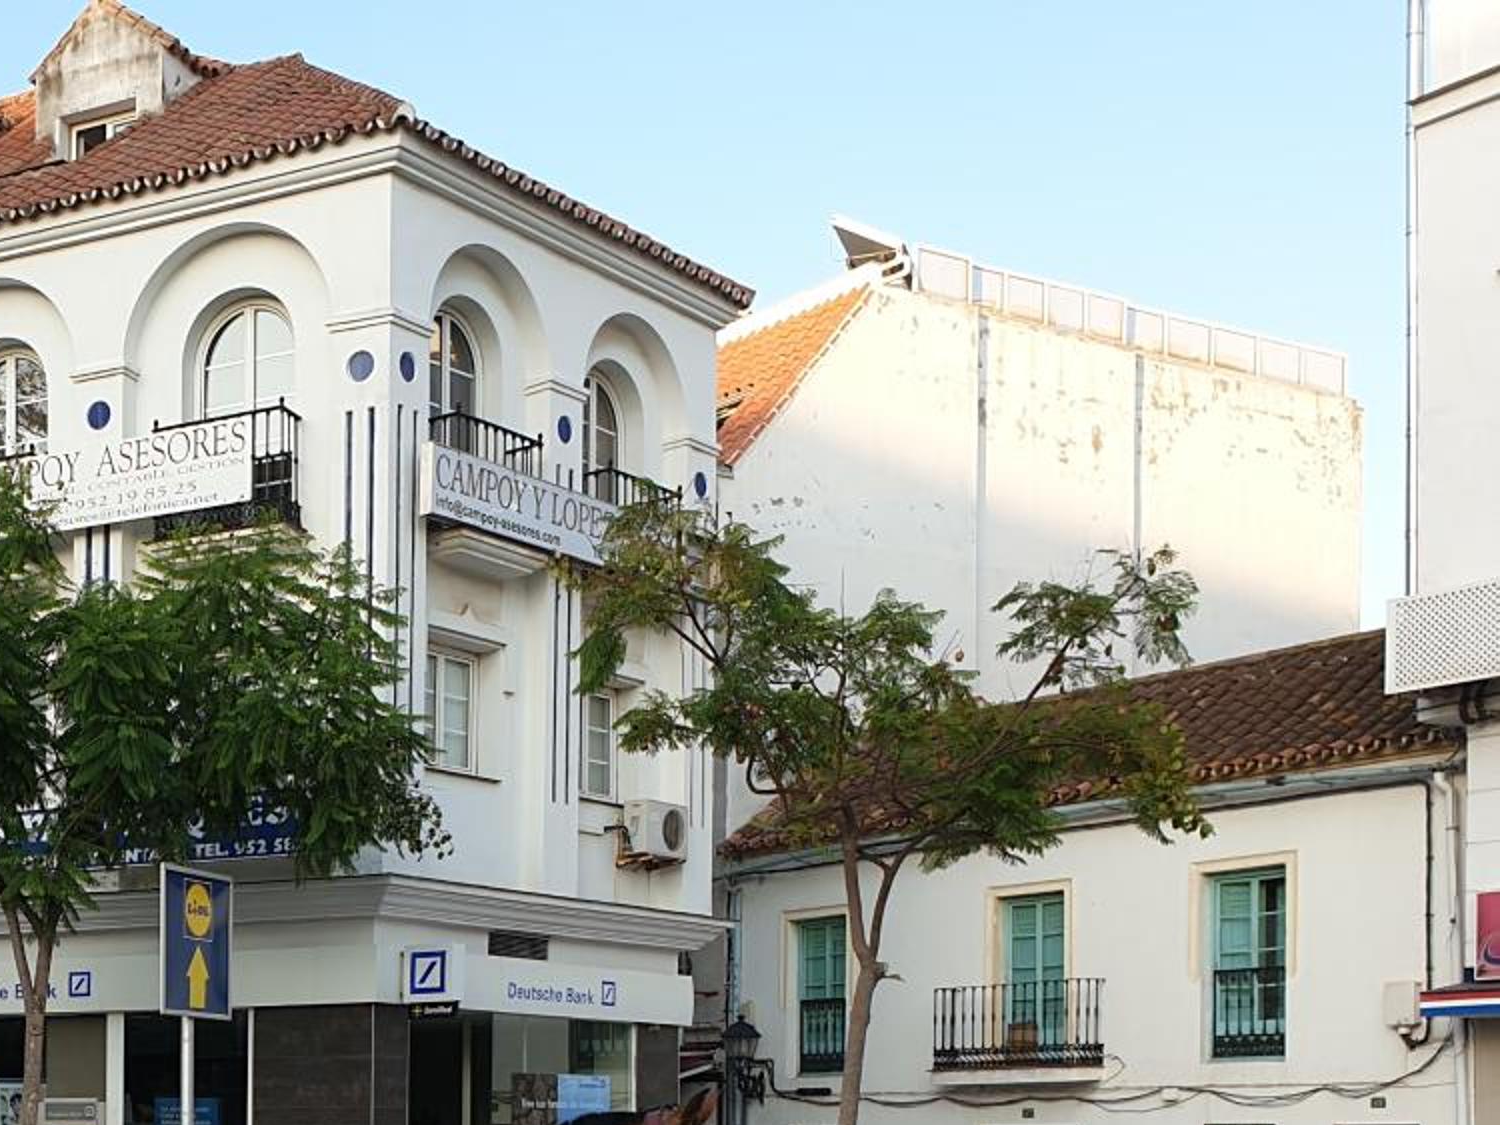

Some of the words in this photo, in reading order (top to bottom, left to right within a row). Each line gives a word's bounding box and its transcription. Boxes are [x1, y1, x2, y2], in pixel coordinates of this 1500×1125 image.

[97, 420, 246, 480] ASESORES
[435, 453, 528, 515] CAMPOY
[531, 483, 547, 520] Y
[194, 842, 228, 858] TEL.
[15, 984, 57, 999] Bk
[507, 981, 563, 1003] Deutsche
[565, 987, 595, 1005] Bank
